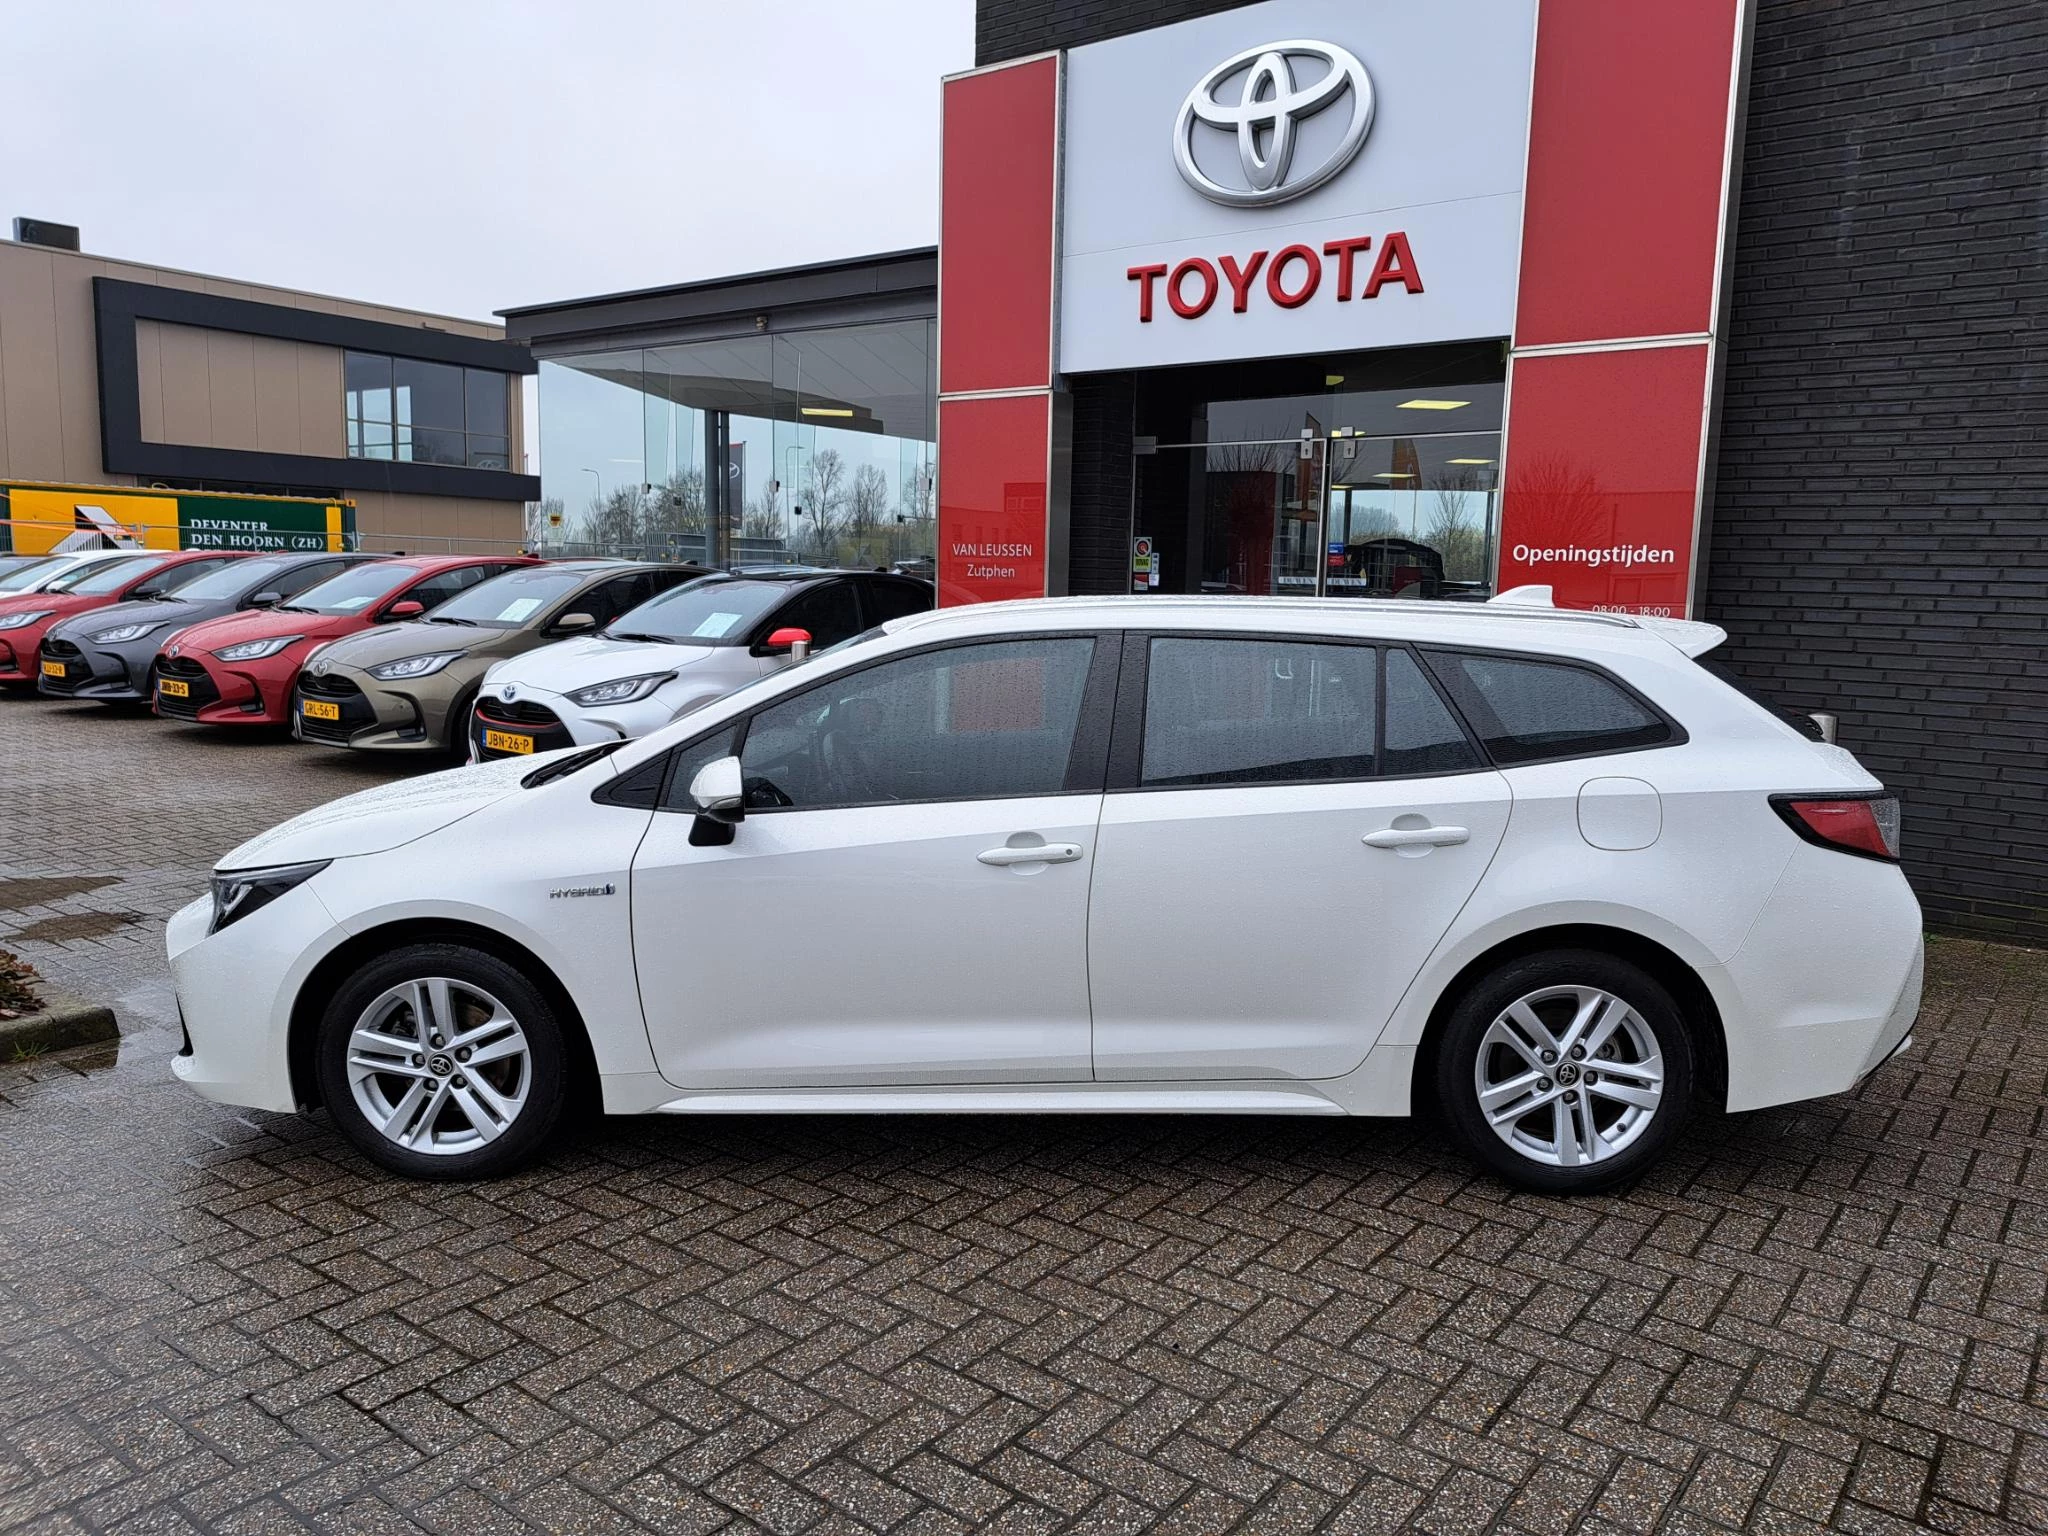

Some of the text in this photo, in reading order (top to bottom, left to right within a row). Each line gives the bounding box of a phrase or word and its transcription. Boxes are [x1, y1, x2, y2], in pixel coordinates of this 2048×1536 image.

[1127, 231, 1424, 323] TOYOTA
[190, 519, 268, 531] DEVENTER
[191, 534, 324, 549] DEN HOORN (ZH)
[952, 543, 1032, 557] VAN LEUSSEN
[1512, 544, 1674, 567] Openingstijden
[966, 564, 1015, 580] Zutphen
[1592, 605, 1627, 614] 08:00
[1639, 606, 1671, 617] 18:00
[304, 702, 336, 718] GRL-56-T
[488, 733, 530, 752] JBN-26-P
[549, 886, 605, 898] HYBRID
